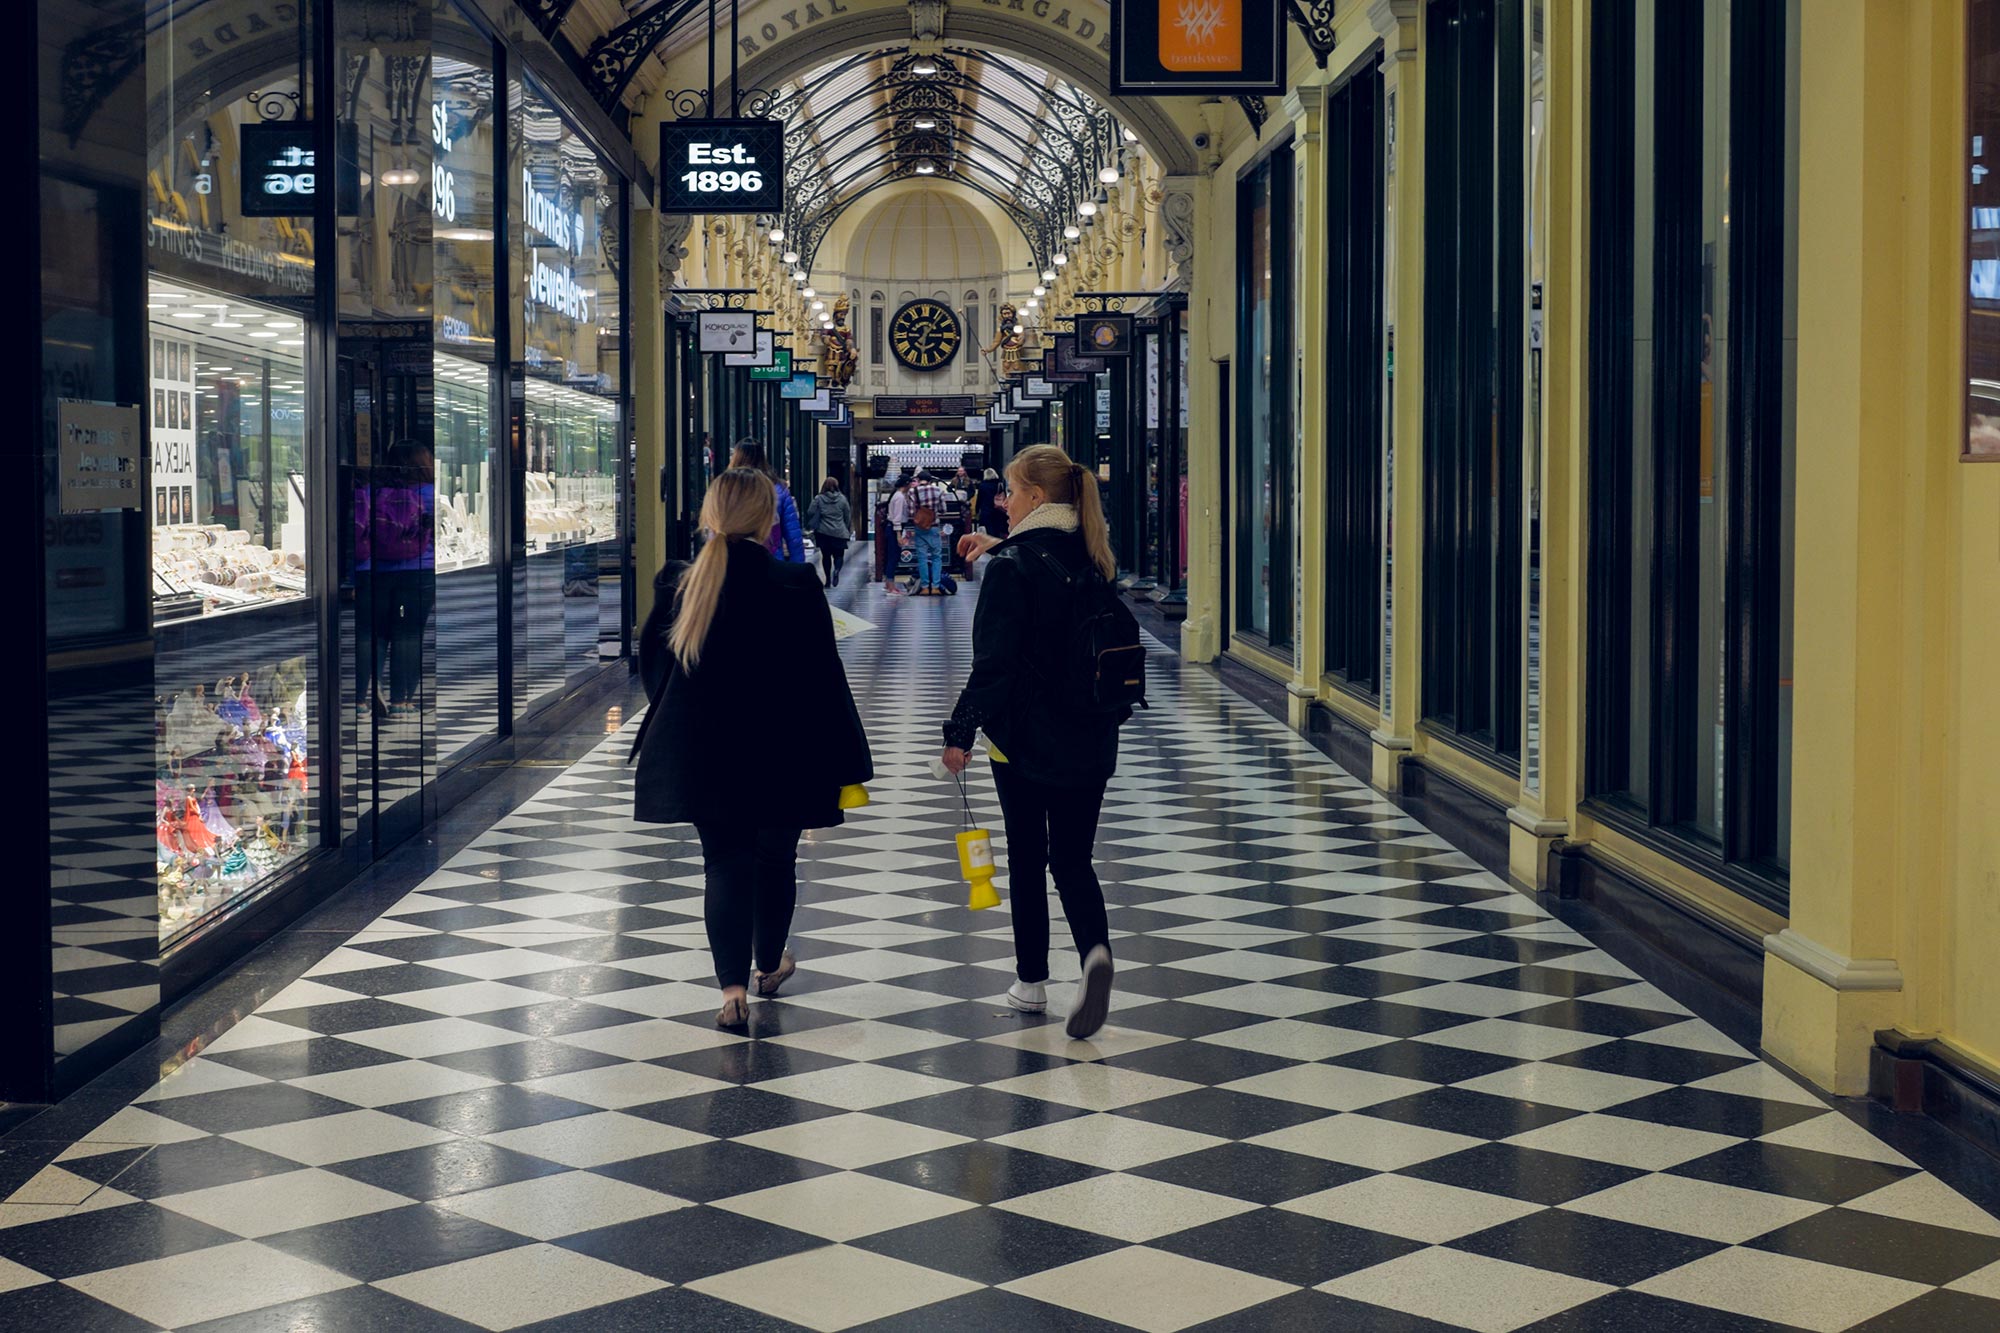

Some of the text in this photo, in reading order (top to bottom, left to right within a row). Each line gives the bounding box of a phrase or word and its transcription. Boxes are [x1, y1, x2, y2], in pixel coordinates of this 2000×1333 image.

[739, 0, 848, 57] ROYAL
[681, 171, 762, 192] 1896
[688, 143, 755, 164] Est.
[432, 162, 455, 222] 96
[160, 213, 202, 261] RINGS
[221, 235, 274, 283] WEDDING
[529, 247, 588, 324] Jewellers
[705, 323, 730, 331] KOKO
